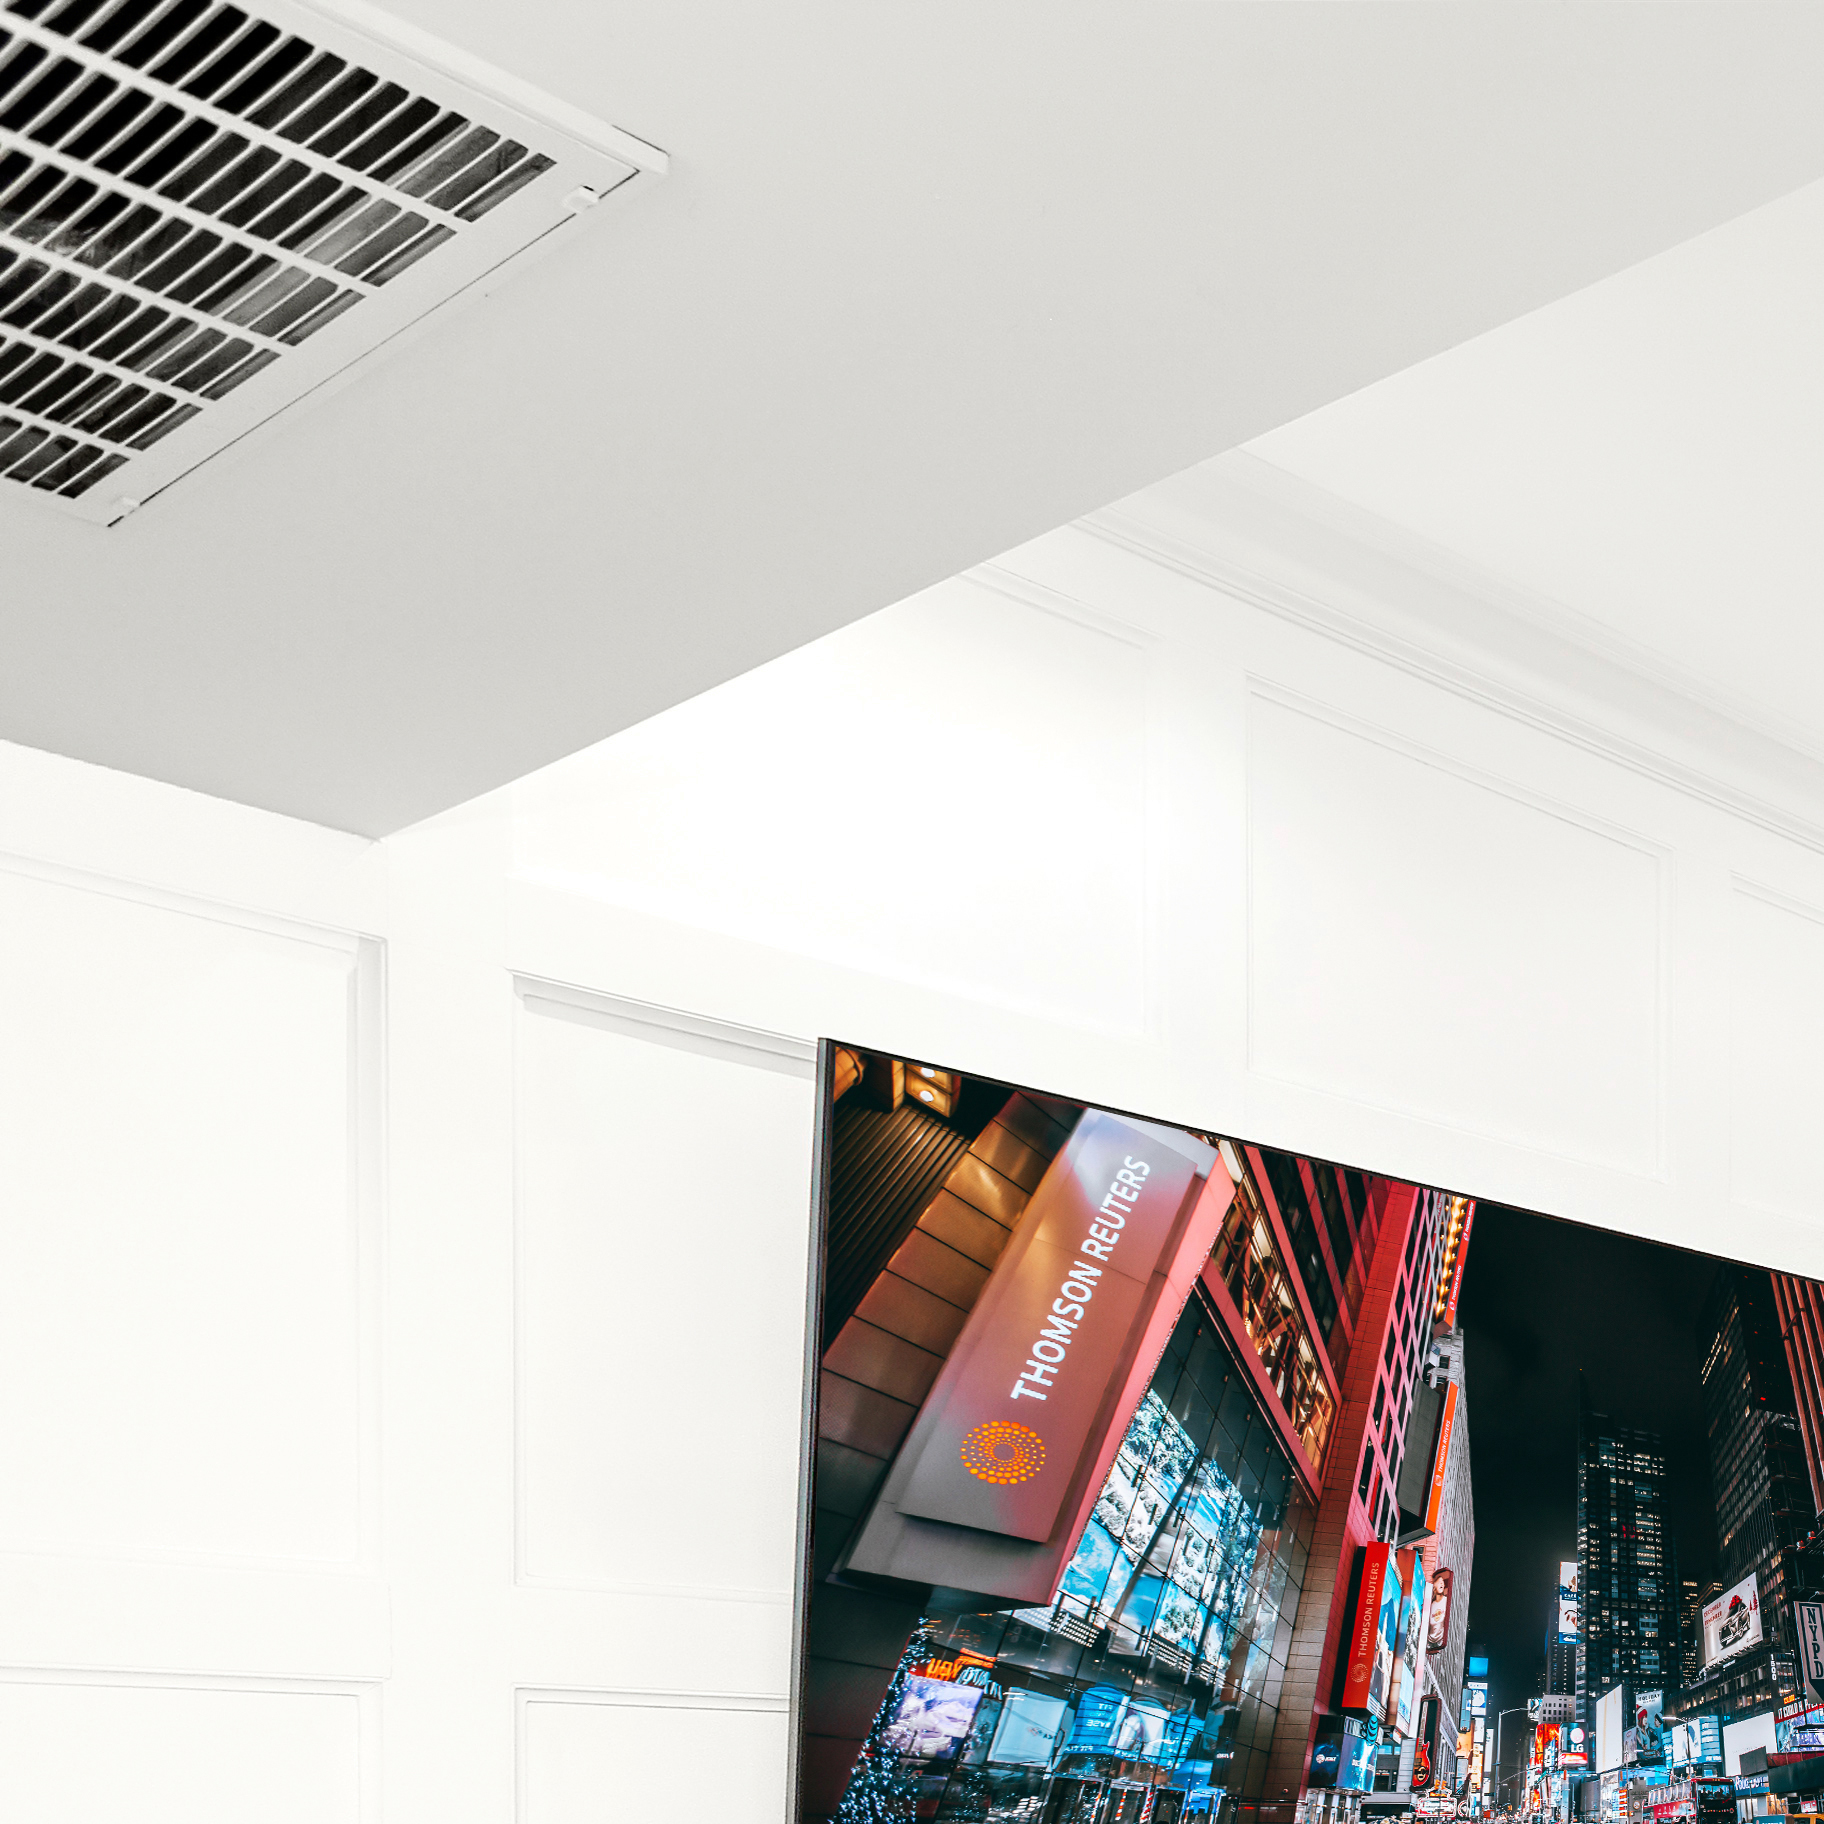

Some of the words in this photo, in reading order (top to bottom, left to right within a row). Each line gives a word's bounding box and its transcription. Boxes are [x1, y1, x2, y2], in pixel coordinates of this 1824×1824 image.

[1010, 1260, 1103, 1402] THOMSON
[1080, 1155, 1151, 1262] REUTERS
[1437, 1444, 1447, 1472] THOMSON
[1442, 1420, 1451, 1444] REUTERS
[1358, 1607, 1373, 1658] THOMSON
[1366, 1562, 1380, 1605] REUTERS
[1806, 1608, 1824, 1678] NYPD
[1570, 1744, 1585, 1753] LG
